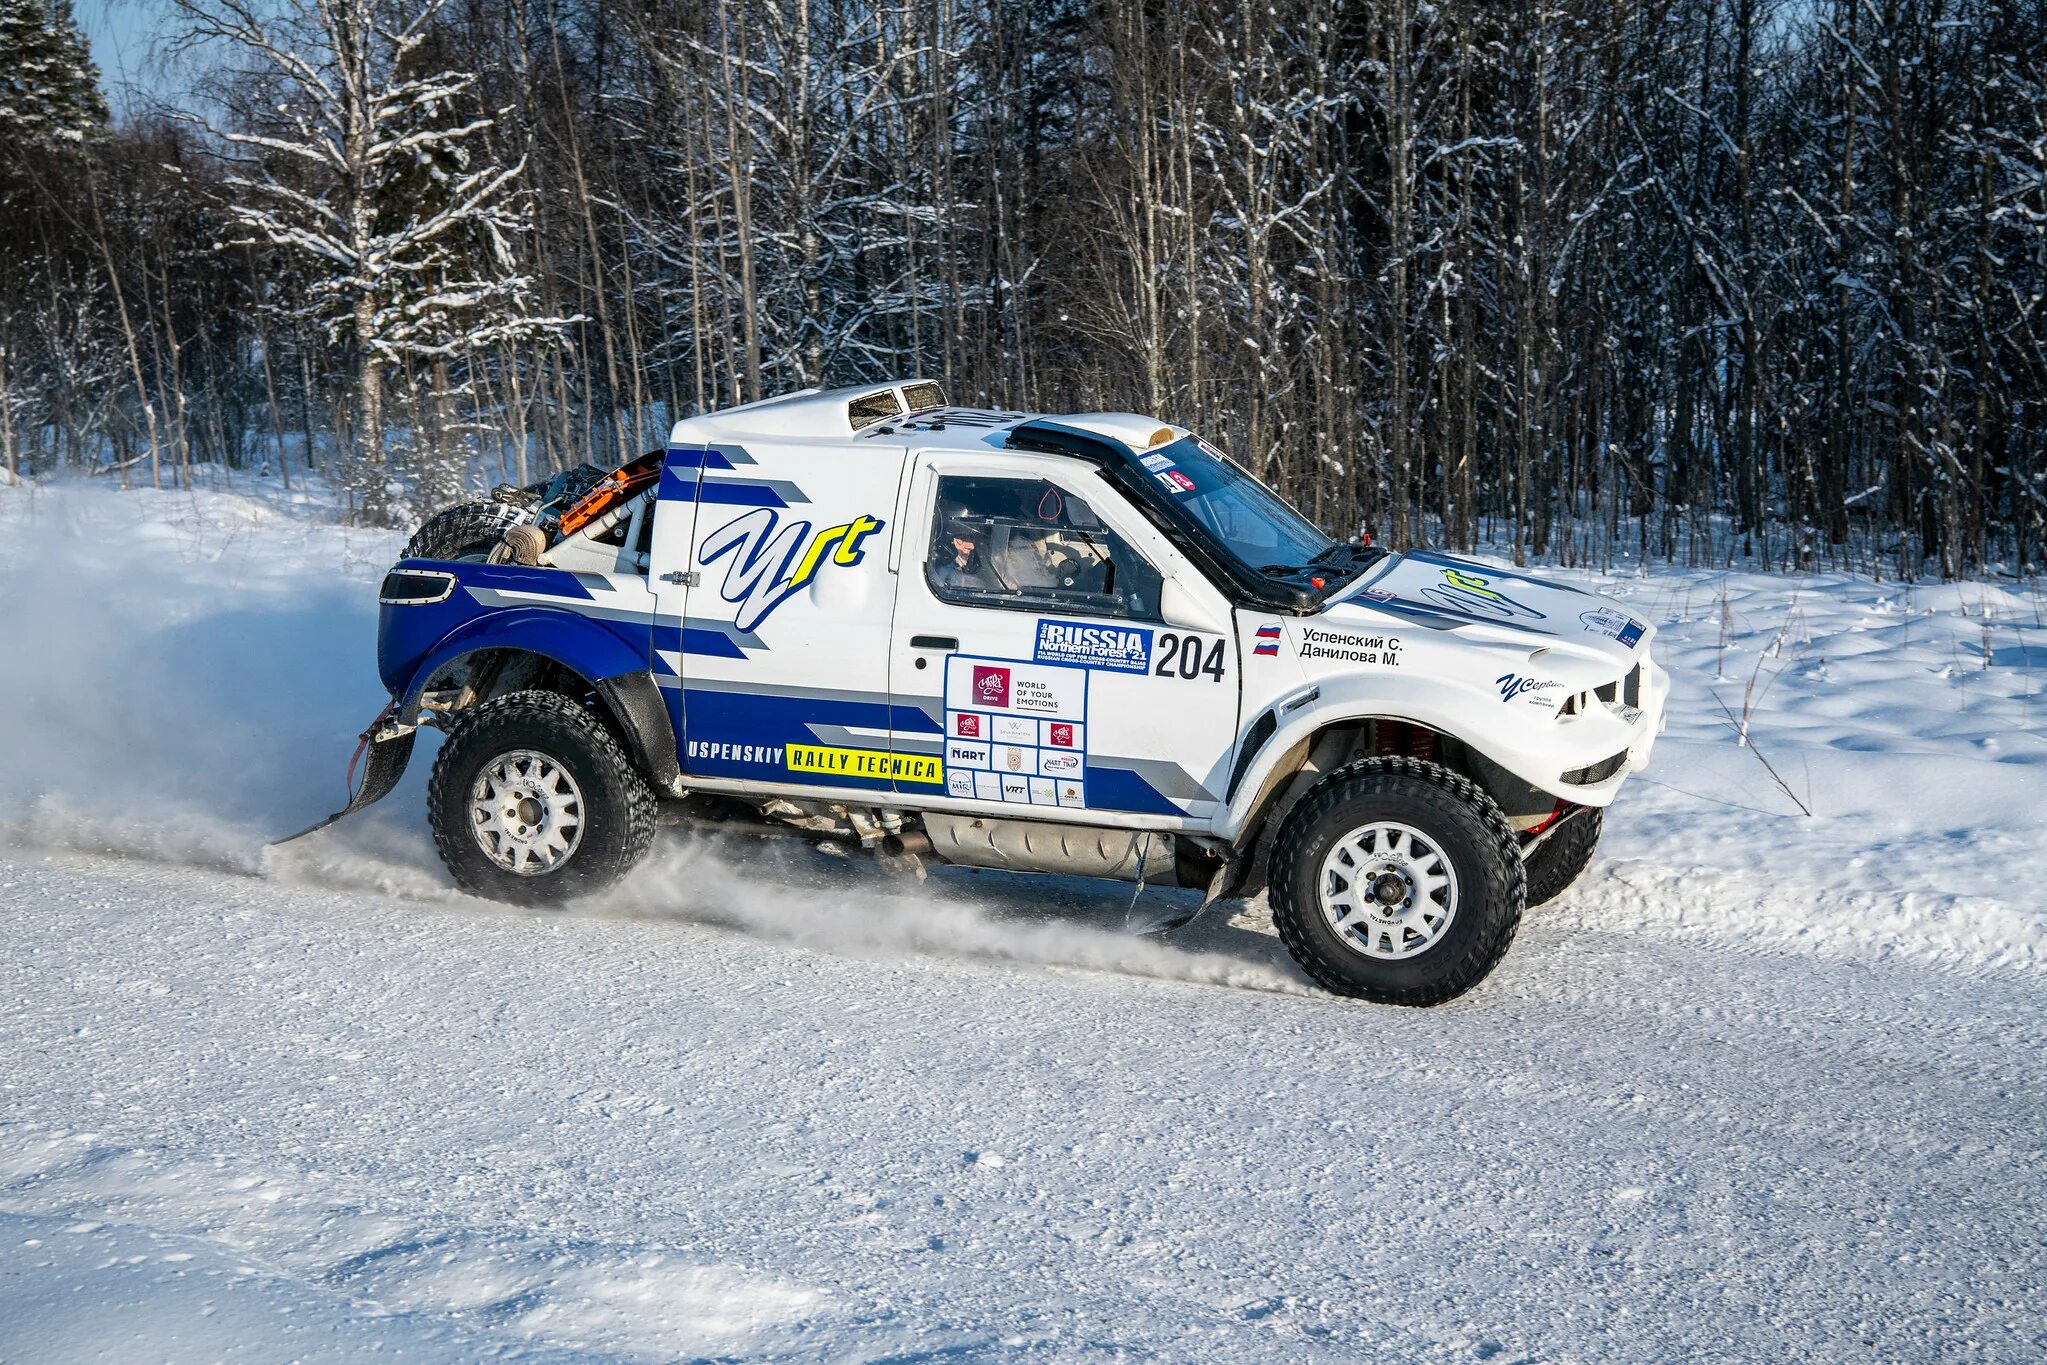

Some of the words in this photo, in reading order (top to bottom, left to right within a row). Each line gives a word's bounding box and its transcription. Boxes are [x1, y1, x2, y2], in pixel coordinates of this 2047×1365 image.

[1039, 639, 1091, 655] Northern
[1091, 644, 1128, 659] Forest
[1046, 625, 1143, 652] RUSSIA
[1303, 628, 1383, 649] Успенский
[1388, 638, 1403, 651] С.
[1155, 633, 1226, 683] 204
[1300, 643, 1377, 664] Данилова
[1382, 652, 1400, 666] М.
[1016, 681, 1047, 690] WORLD
[1031, 691, 1053, 699] YOUR
[1016, 698, 1059, 708] EMOTIONS
[688, 740, 784, 765] USPENSKIY
[952, 749, 986, 761] NART
[793, 749, 849, 770] RALLY
[857, 755, 936, 778] TECNICA
[1005, 785, 1026, 794] VRT
